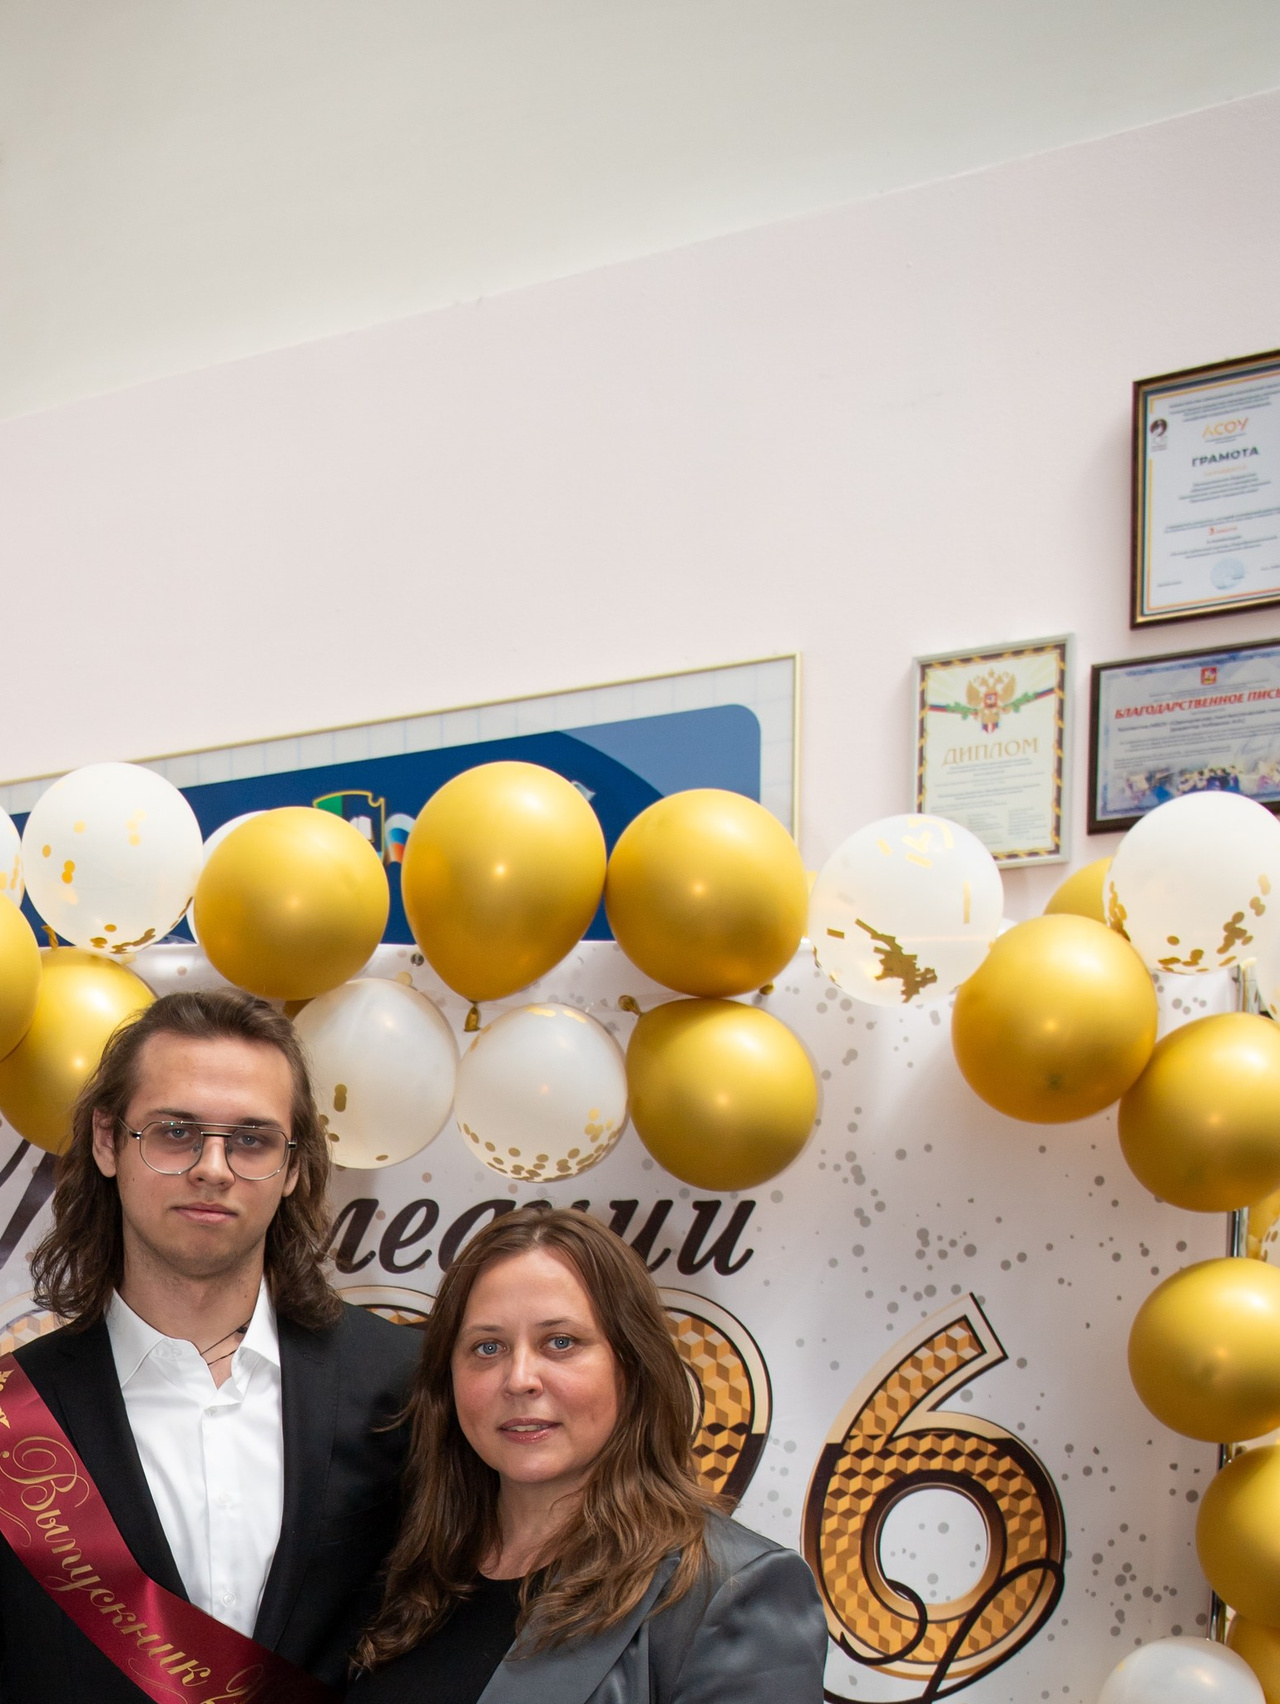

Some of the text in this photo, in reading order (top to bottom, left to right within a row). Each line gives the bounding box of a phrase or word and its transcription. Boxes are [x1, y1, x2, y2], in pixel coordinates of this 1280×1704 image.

[1191, 446, 1259, 467] ГРАМОТА
[1114, 692, 1245, 719] БЛАГОДАРСТВЕННОЕ
[942, 738, 1039, 766] ДИПЛОМ
